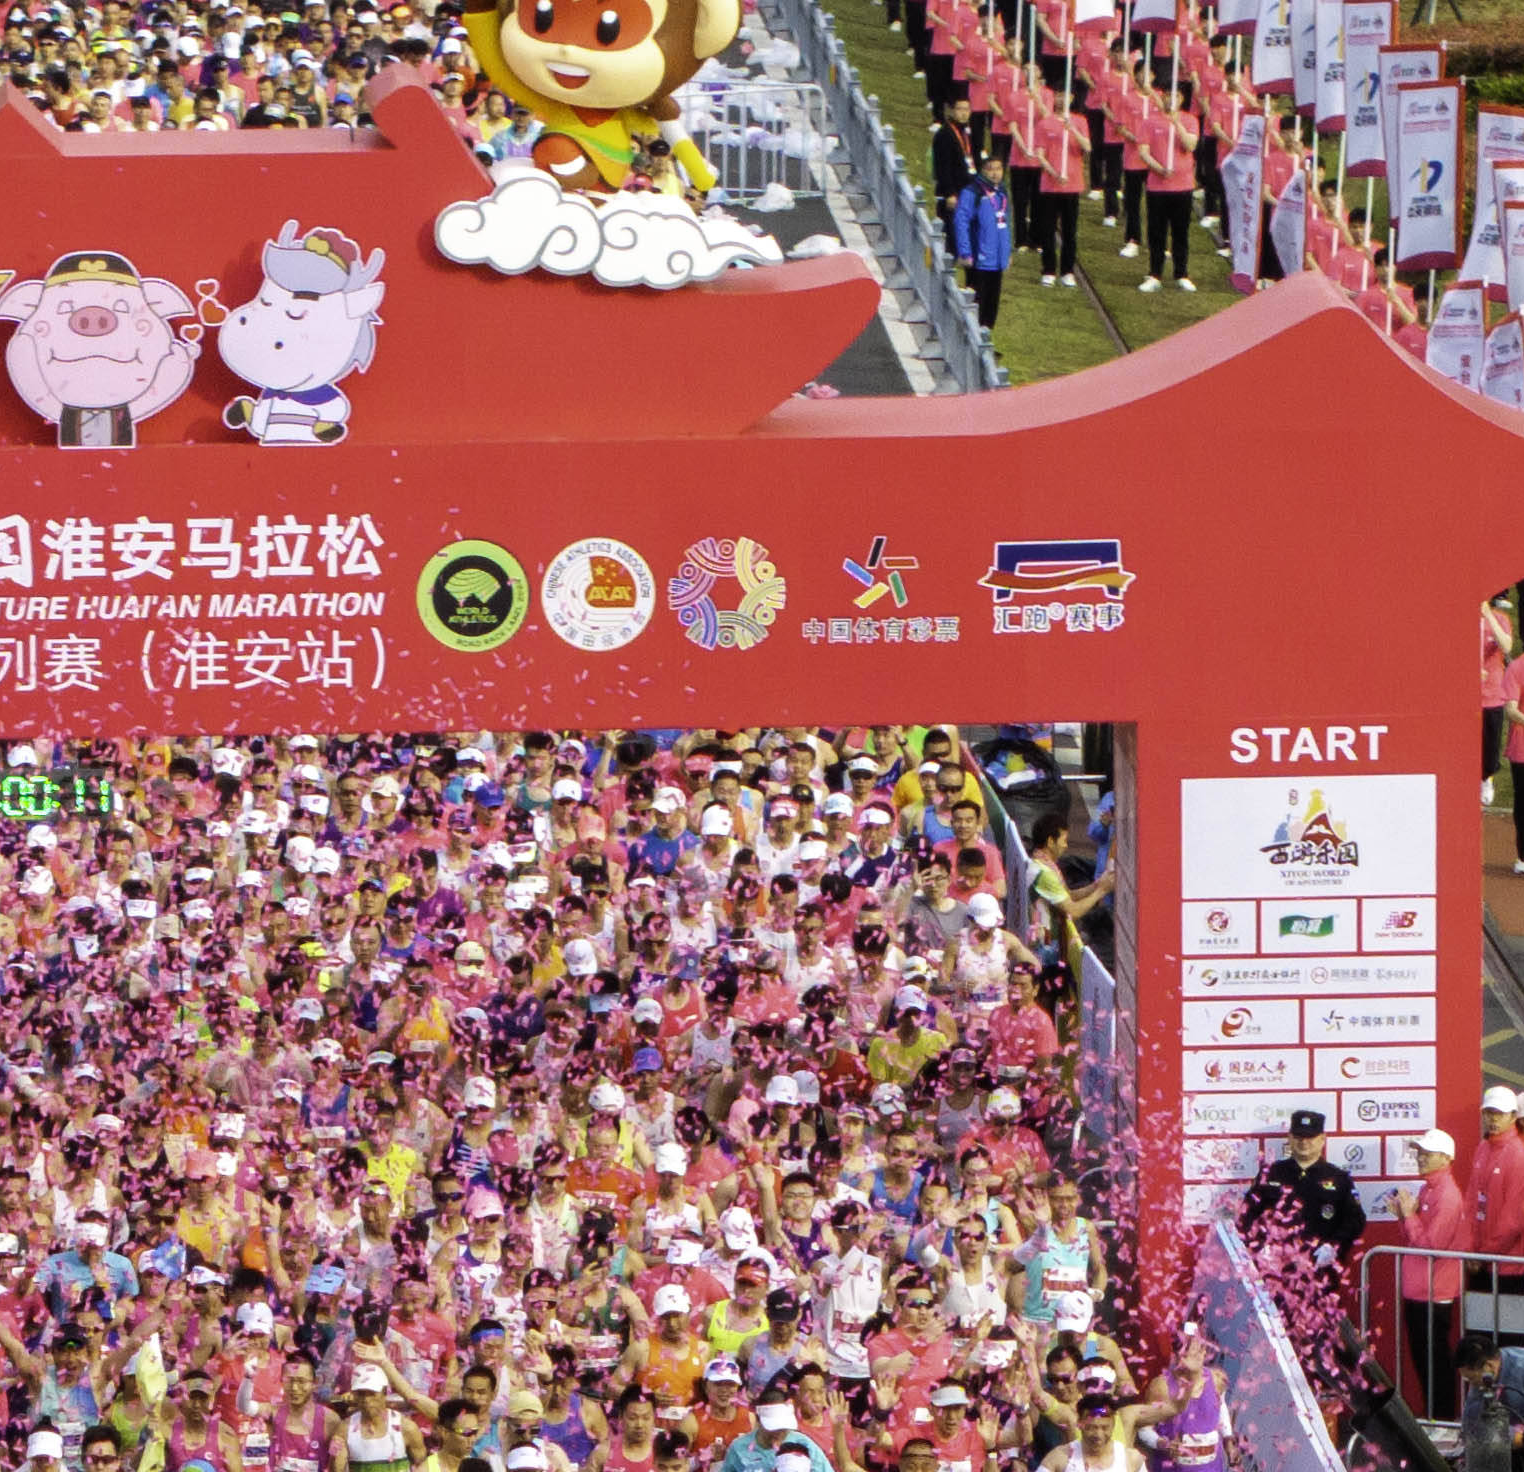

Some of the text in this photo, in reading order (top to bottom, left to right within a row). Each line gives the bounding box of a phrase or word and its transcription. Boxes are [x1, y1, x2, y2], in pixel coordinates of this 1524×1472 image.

[77, 594, 201, 620] HUAI'AN
[209, 592, 384, 618] MARATHON
[802, 616, 960, 644] 中国体育彩票
[1230, 725, 1388, 763] START
